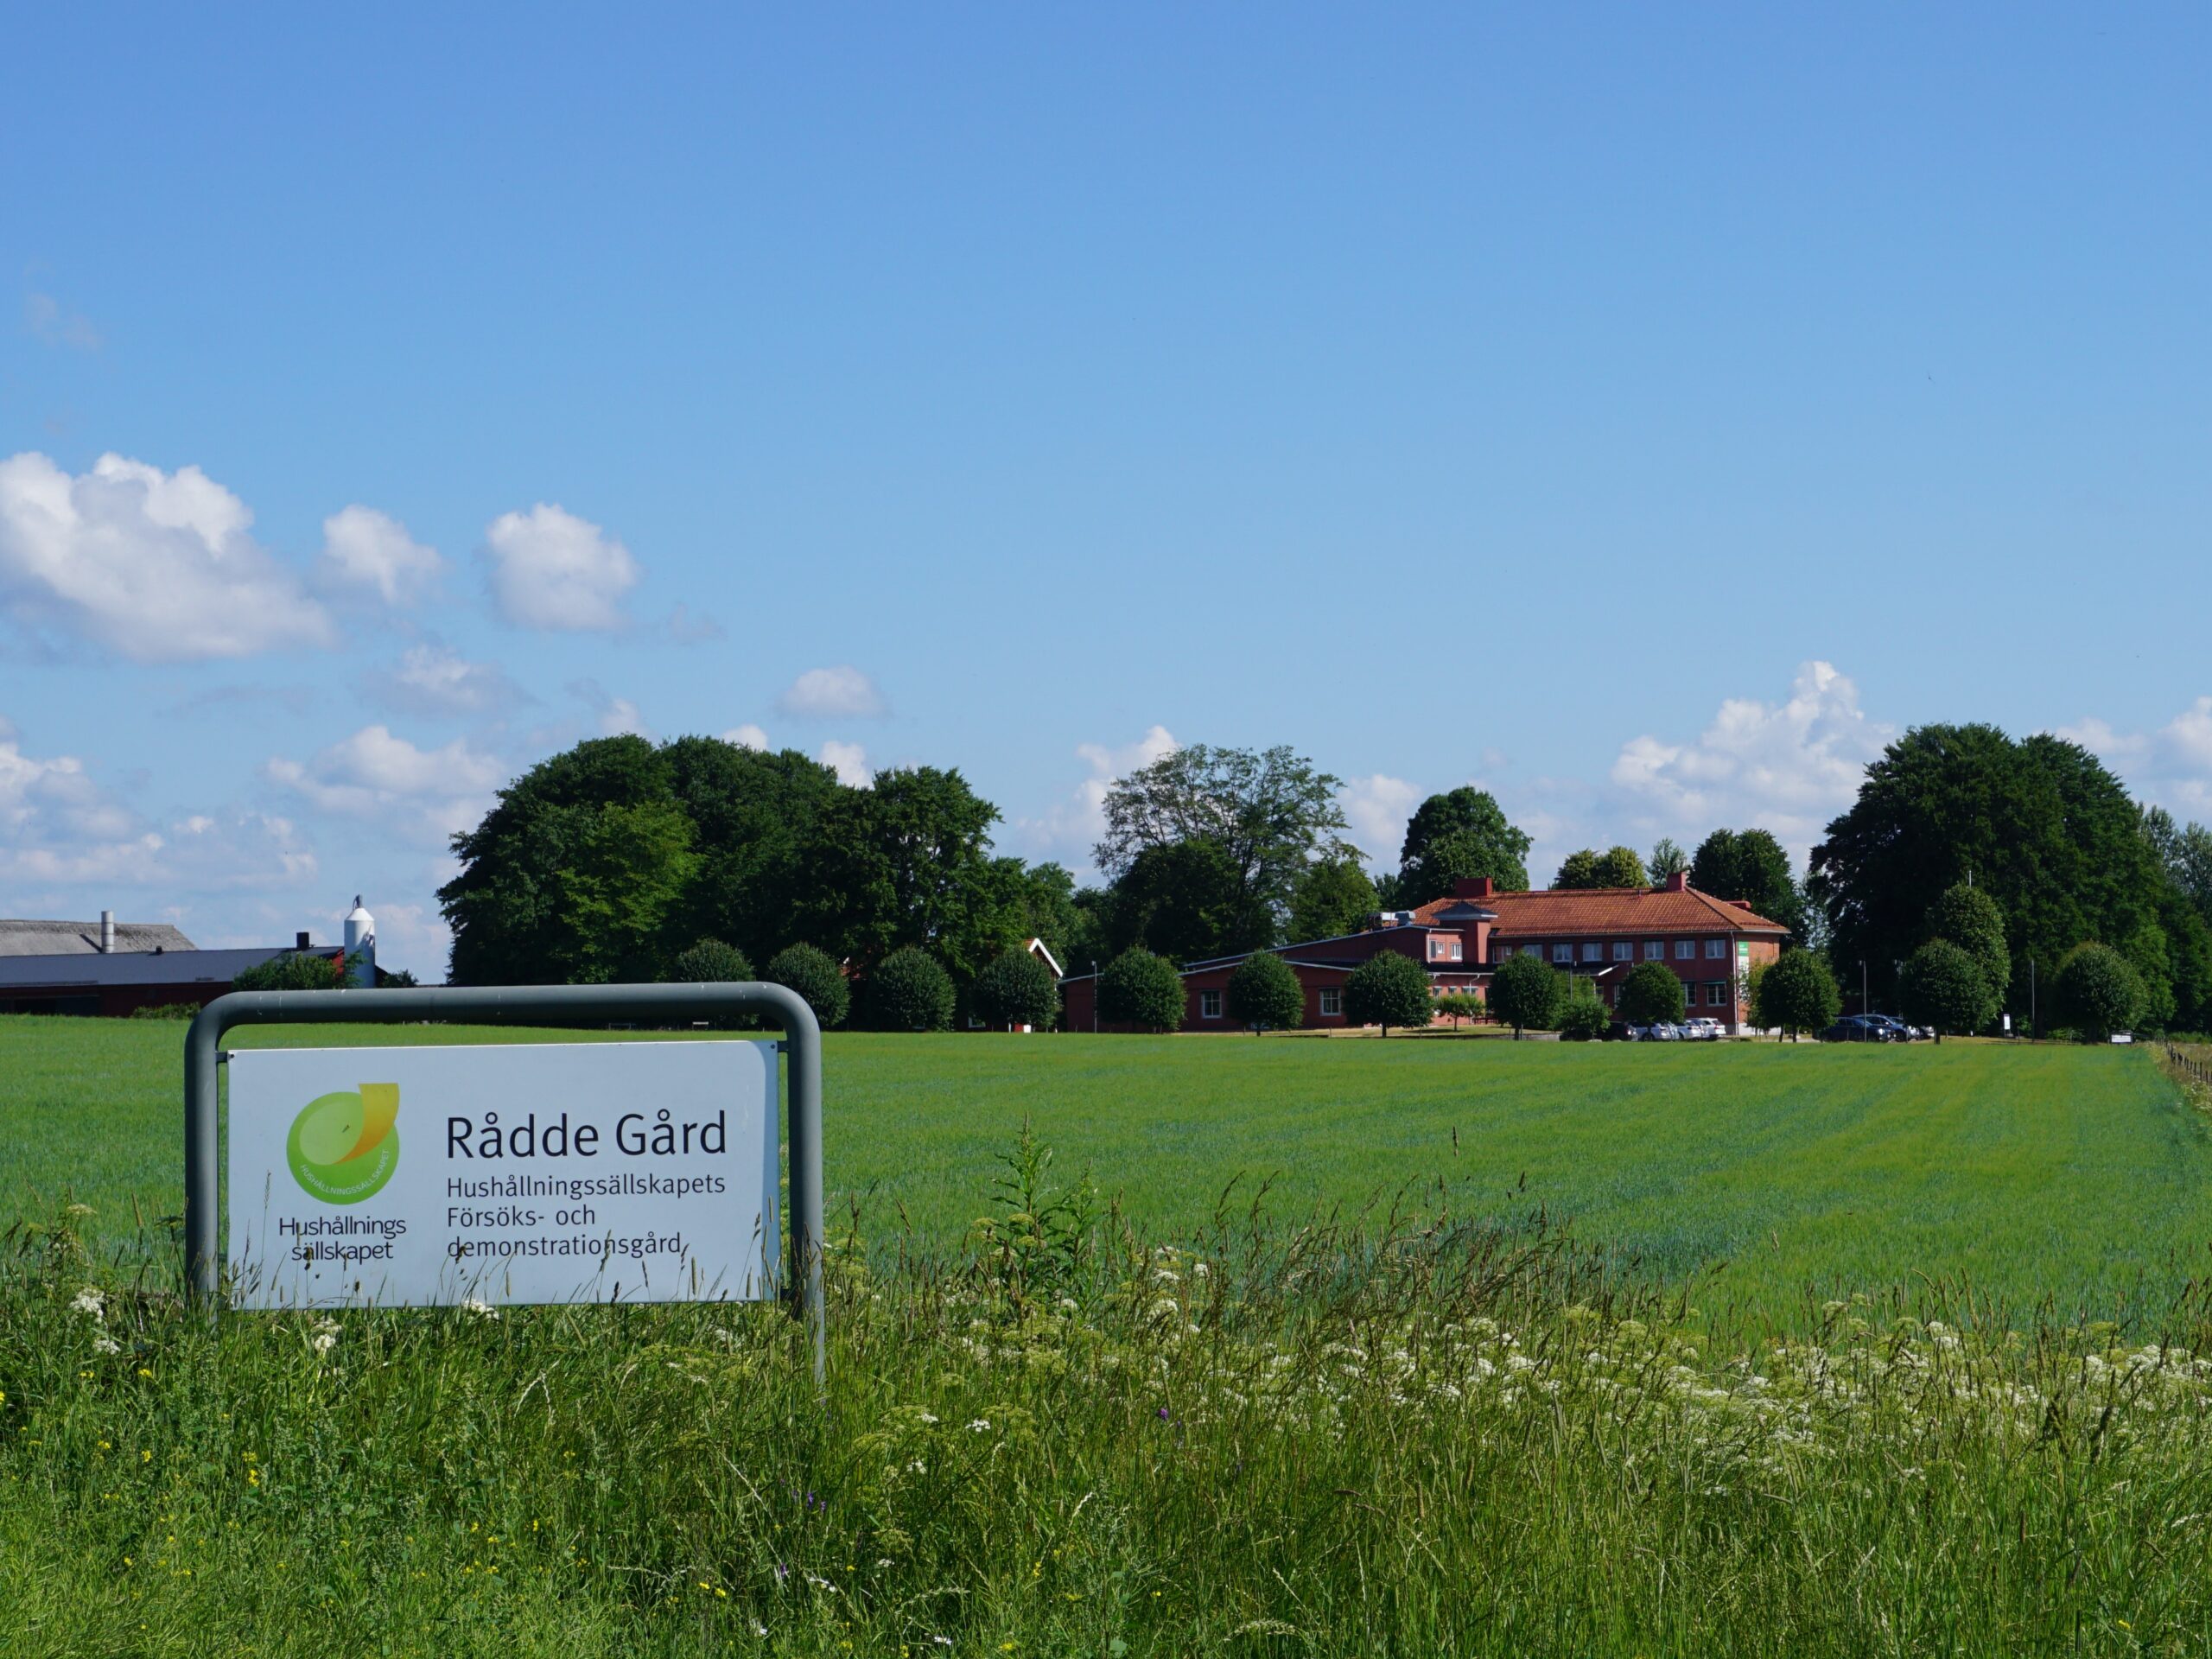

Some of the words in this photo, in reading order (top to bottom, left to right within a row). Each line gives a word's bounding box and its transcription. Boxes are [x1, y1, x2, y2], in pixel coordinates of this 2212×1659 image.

[448, 1111, 599, 1159] Rådde
[616, 1109, 727, 1155] Gård
[448, 1173, 726, 1200] Hushållningssällskapets
[279, 1215, 406, 1241] Hushållnings
[448, 1205, 544, 1228] Försöks-
[556, 1205, 595, 1226] och
[291, 1240, 393, 1265] sällskapet
[448, 1231, 681, 1259] demonstrationsgård
